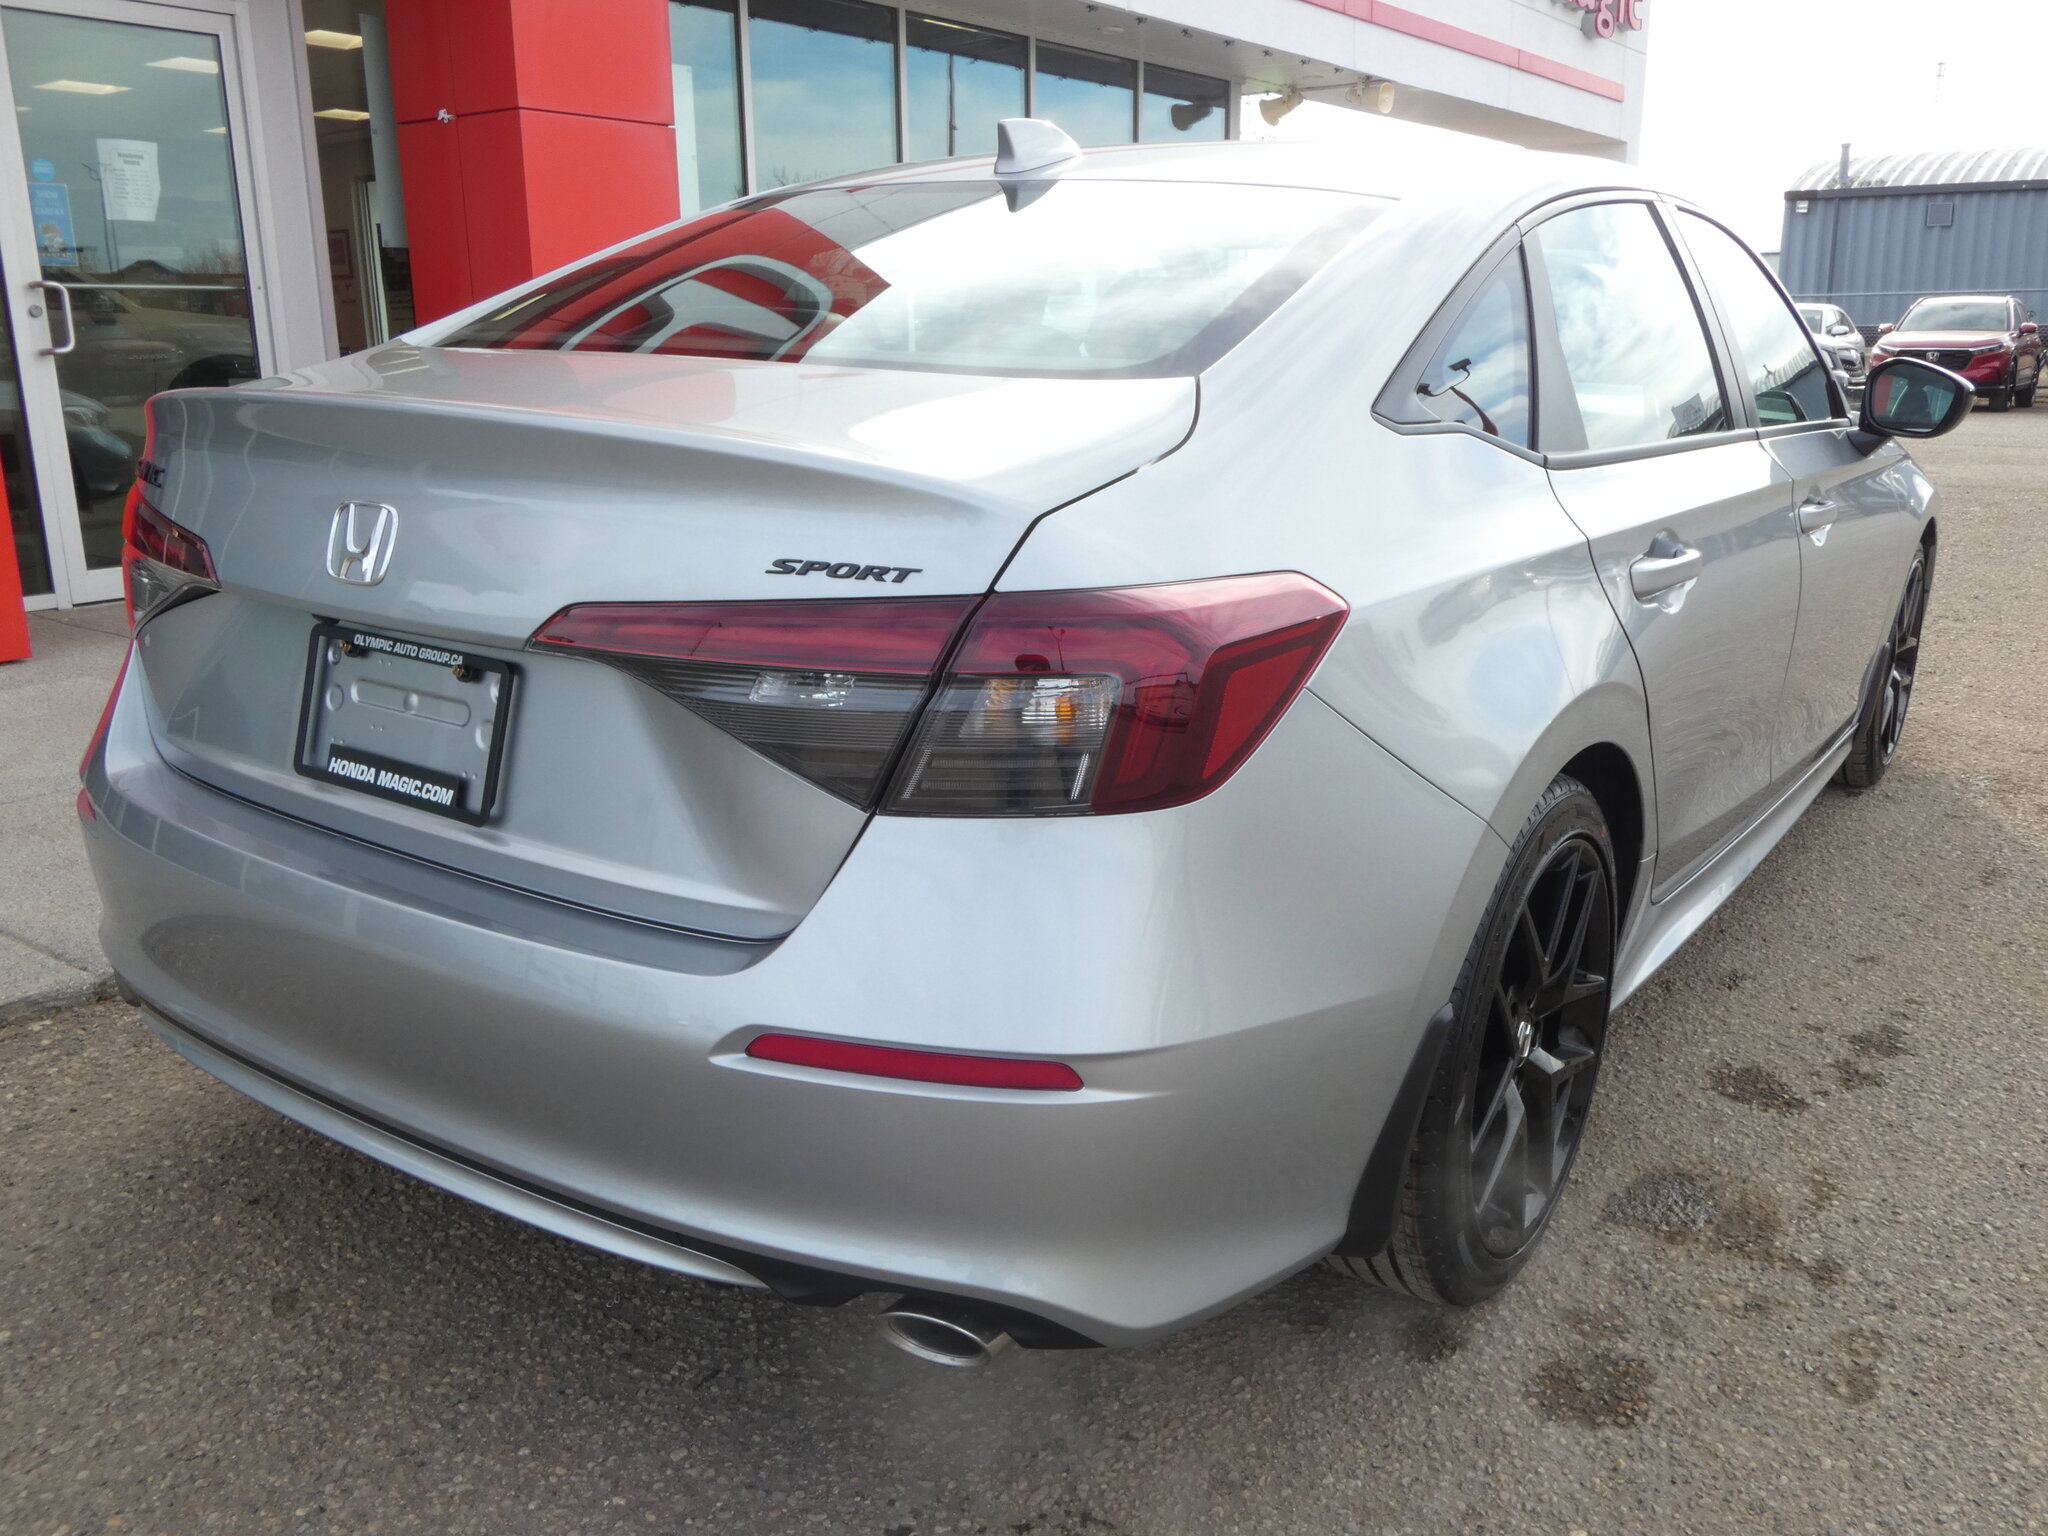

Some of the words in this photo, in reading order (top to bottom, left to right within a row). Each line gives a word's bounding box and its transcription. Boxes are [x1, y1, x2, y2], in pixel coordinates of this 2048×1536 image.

[1563, 0, 1642, 38] gic
[765, 558, 924, 584] SPORT
[353, 633, 394, 652] OLYMPIC
[393, 642, 418, 657] AUTO
[418, 647, 463, 666] GROUP.CA
[328, 756, 376, 784] HONDA
[376, 769, 454, 806] MAGIC.COM
